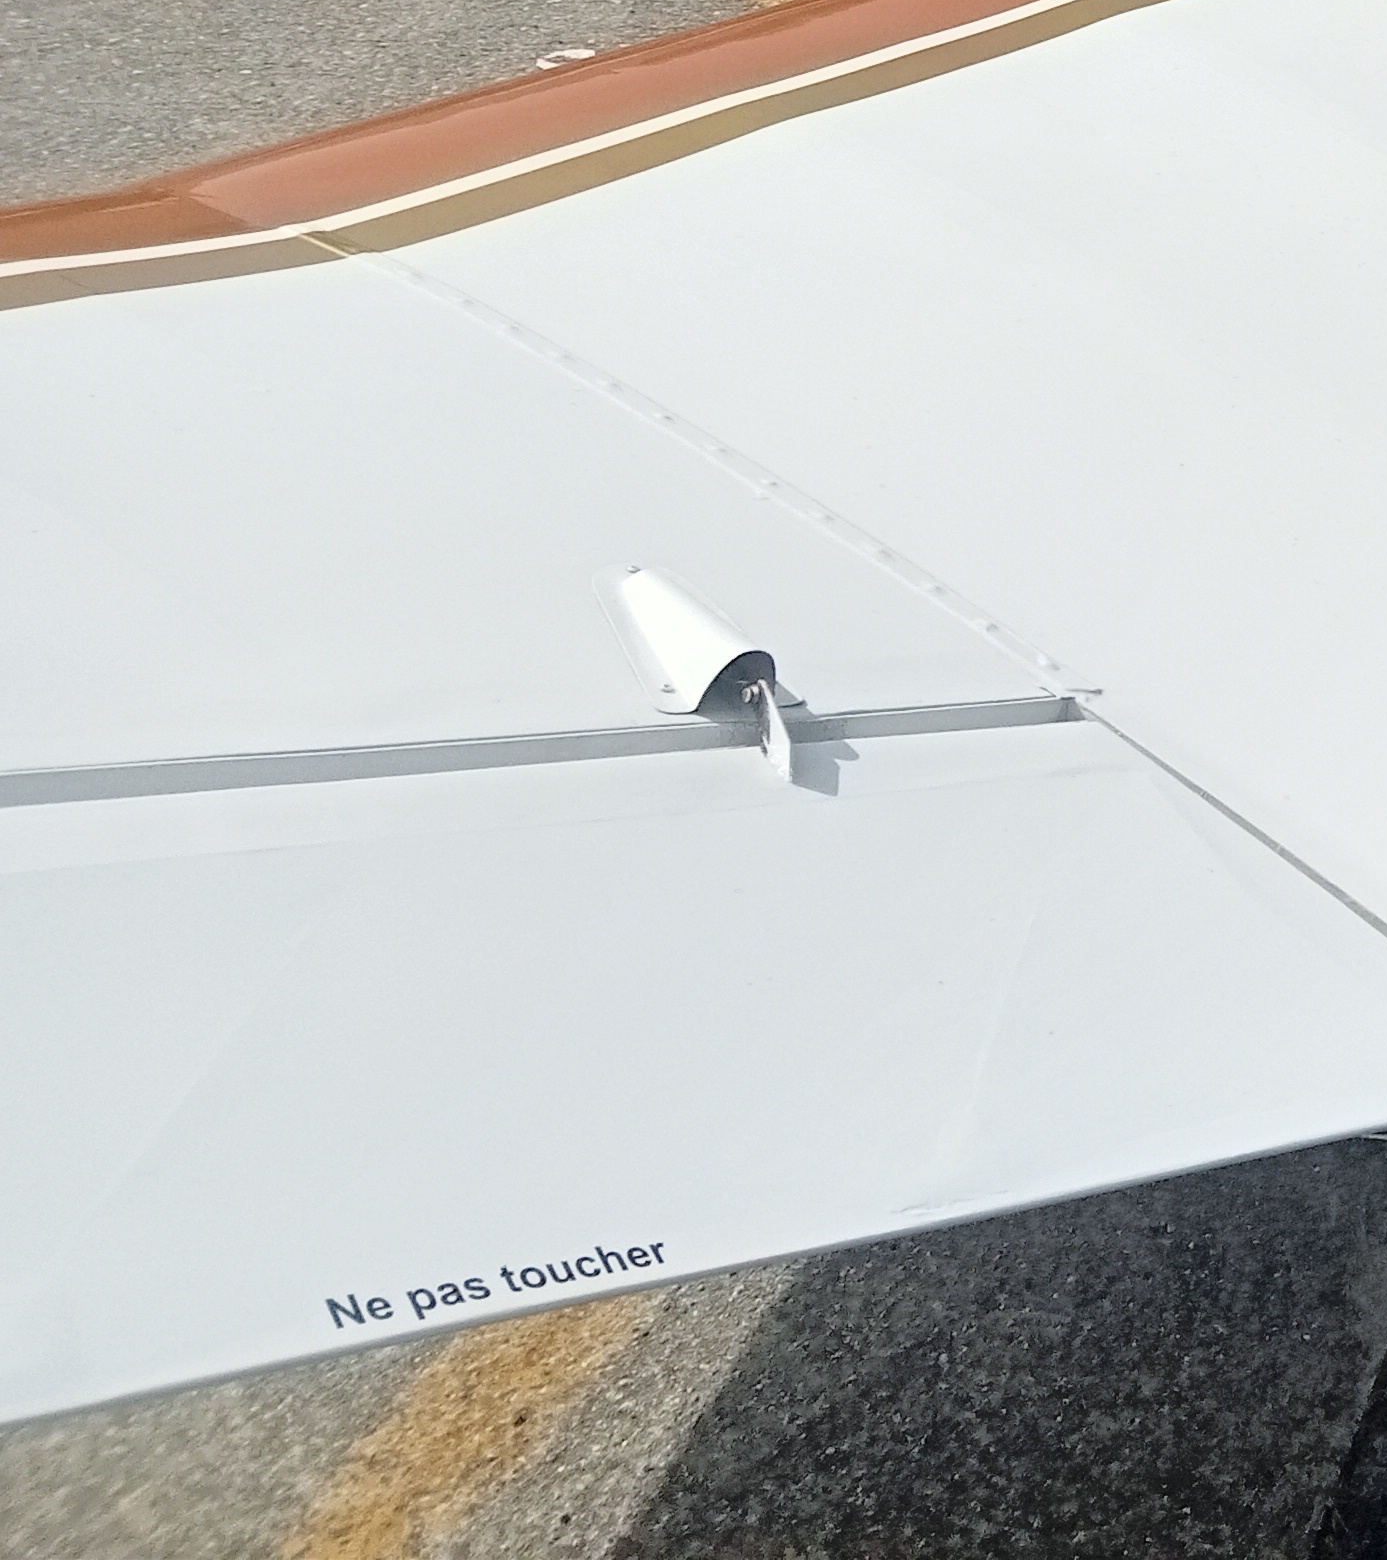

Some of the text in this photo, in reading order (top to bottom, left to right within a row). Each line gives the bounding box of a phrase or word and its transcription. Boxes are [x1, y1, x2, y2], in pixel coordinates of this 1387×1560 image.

[325, 1242, 665, 1329] Ne pas toucher
